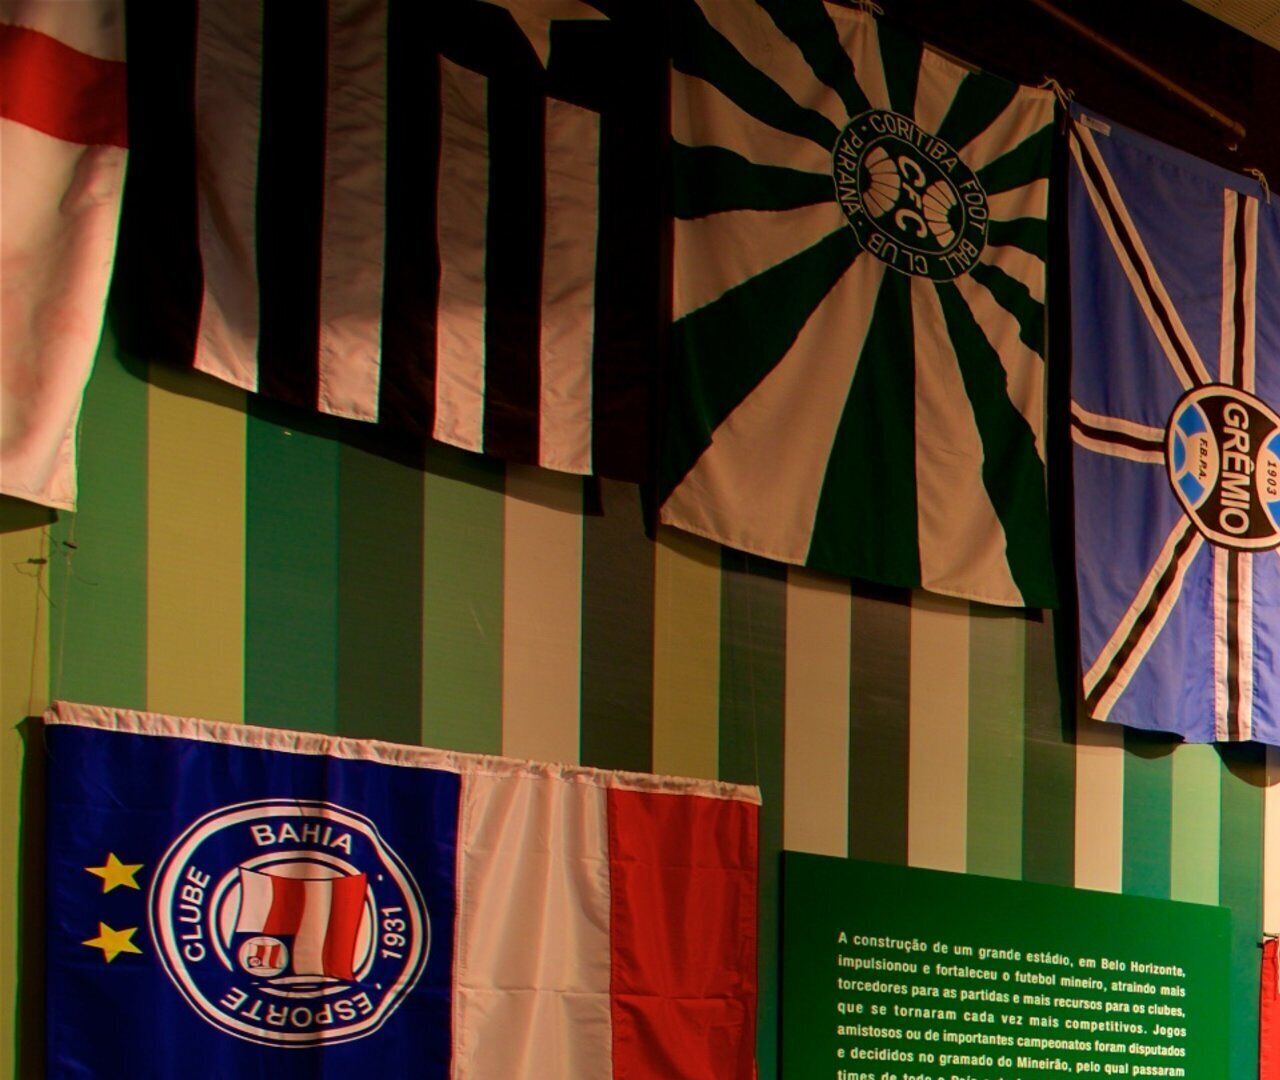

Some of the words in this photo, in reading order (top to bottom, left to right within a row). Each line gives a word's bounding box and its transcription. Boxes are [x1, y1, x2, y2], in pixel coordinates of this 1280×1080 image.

[869, 114, 958, 174] CORITIBA
[959, 179, 988, 235] FOOT
[866, 232, 929, 275] CLUB
[938, 237, 979, 277] BALL
[1218, 402, 1255, 535] GRÊMIO
[1266, 461, 1277, 496] 1903
[250, 822, 353, 855] BAHIA
[181, 866, 212, 963] CLUBE
[382, 907, 404, 960] 1931
[838, 932, 846, 943] A
[853, 935, 926, 952] construção
[933, 941, 947, 953] de
[953, 945, 972, 955] um
[978, 948, 1020, 960] grande
[1026, 952, 1073, 967] estádio,
[1078, 958, 1095, 968] em
[1101, 958, 1125, 971] Belo
[1130, 961, 1185, 977] Horizonte,
[838, 954, 916, 972] impulsionou
[922, 964, 929, 974] e
[936, 963, 996, 980] fortaleceu
[1002, 972, 1009, 981] o
[1014, 970, 1055, 985] futebol
[1060, 976, 1106, 991] mineiro,
[1111, 980, 1156, 994] atraindo
[1160, 985, 1185, 997] mais
[220, 986, 374, 1029] ESPORTE
[838, 978, 907, 994] torcedores
[911, 986, 938, 997] para
[942, 988, 956, 998] as
[960, 990, 1009, 1002] partidas
[1012, 994, 1019, 1003] e
[1022, 994, 1050, 1006] mais
[1053, 998, 1102, 1010] recursos
[1105, 1002, 1129, 1012] para
[1132, 1004, 1144, 1013] os
[1147, 1004, 1184, 1017] clubes,
[837, 1002, 862, 1013] que
[871, 1004, 886, 1015] se
[894, 1005, 956, 1019] tornaram
[963, 1011, 993, 1023] cada
[1001, 1014, 1022, 1025] vez
[1029, 1016, 1058, 1027] mais
[1065, 1019, 1146, 1033] competitivos.
[1152, 1024, 1186, 1038] Jogos
[837, 1024, 901, 1038] amistosos
[905, 1030, 920, 1039] ou
[924, 1029, 939, 1041] de
[942, 1030, 1013, 1045] importantes
[1016, 1037, 1091, 1051] campeonatos
[1094, 1040, 1125, 1052] foram
[1128, 1042, 1185, 1057] disputados
[837, 1048, 843, 1057] e
[850, 1047, 913, 1061] decididos
[918, 1053, 933, 1063] no
[938, 1054, 992, 1066] gramado
[997, 1056, 1011, 1067] do
[1016, 1056, 1071, 1072] Mineirão,
[1075, 1061, 1100, 1073] pelo
[1103, 1063, 1128, 1075] qual
[1132, 1065, 1184, 1076] passaram
